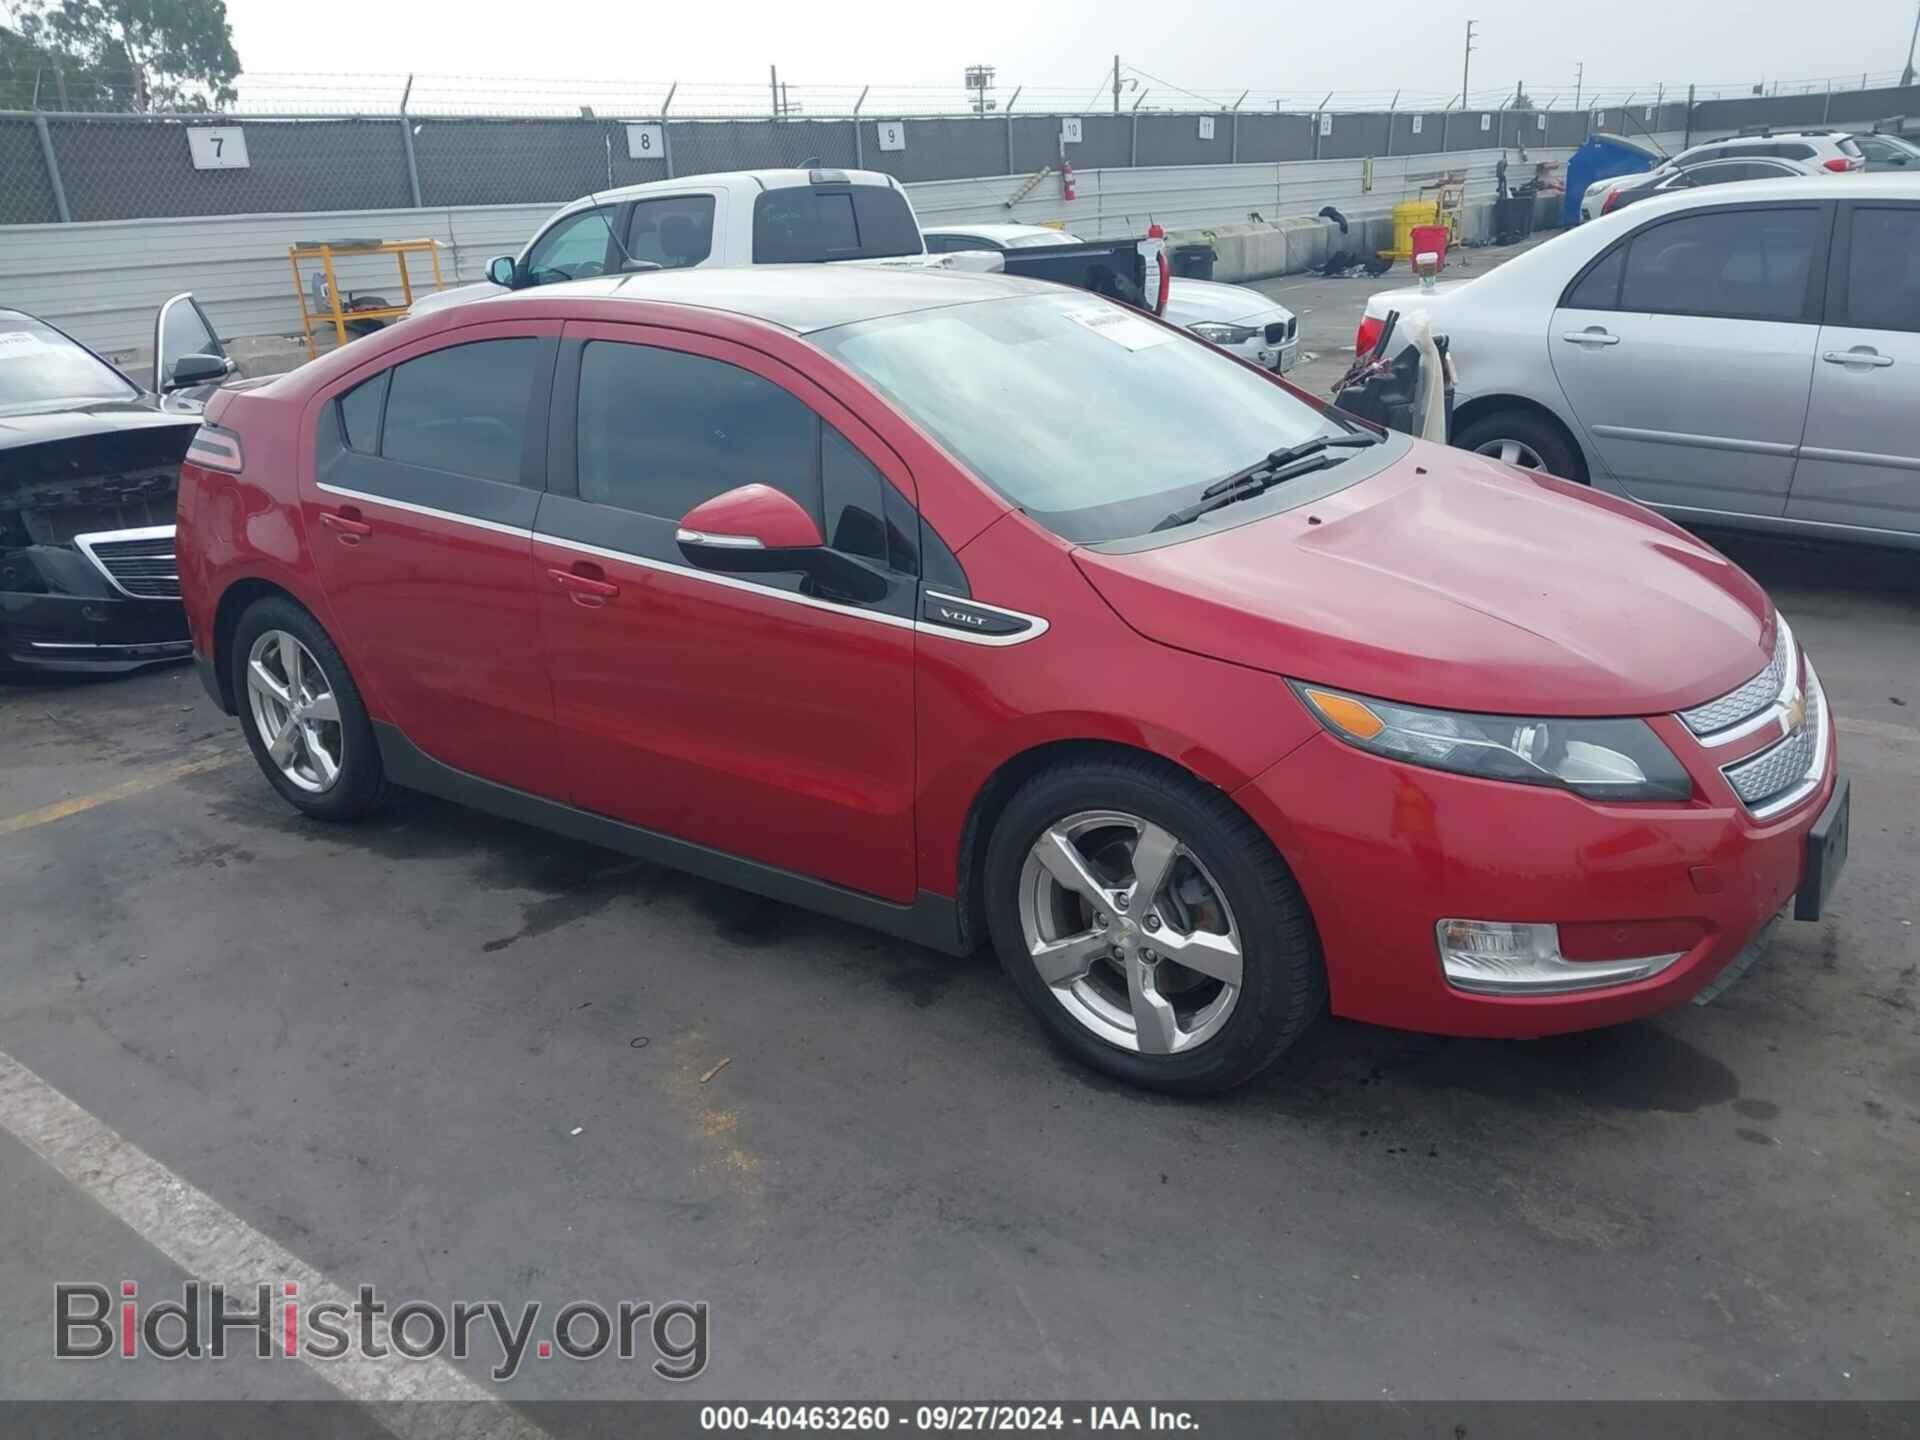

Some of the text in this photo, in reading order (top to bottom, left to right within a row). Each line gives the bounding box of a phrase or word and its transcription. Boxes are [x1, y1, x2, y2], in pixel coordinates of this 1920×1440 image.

[887, 129, 895, 144] 9
[1067, 124, 1078, 137] 10
[210, 138, 224, 158] 7
[641, 133, 650, 150] 8
[940, 608, 988, 625] VOLT
